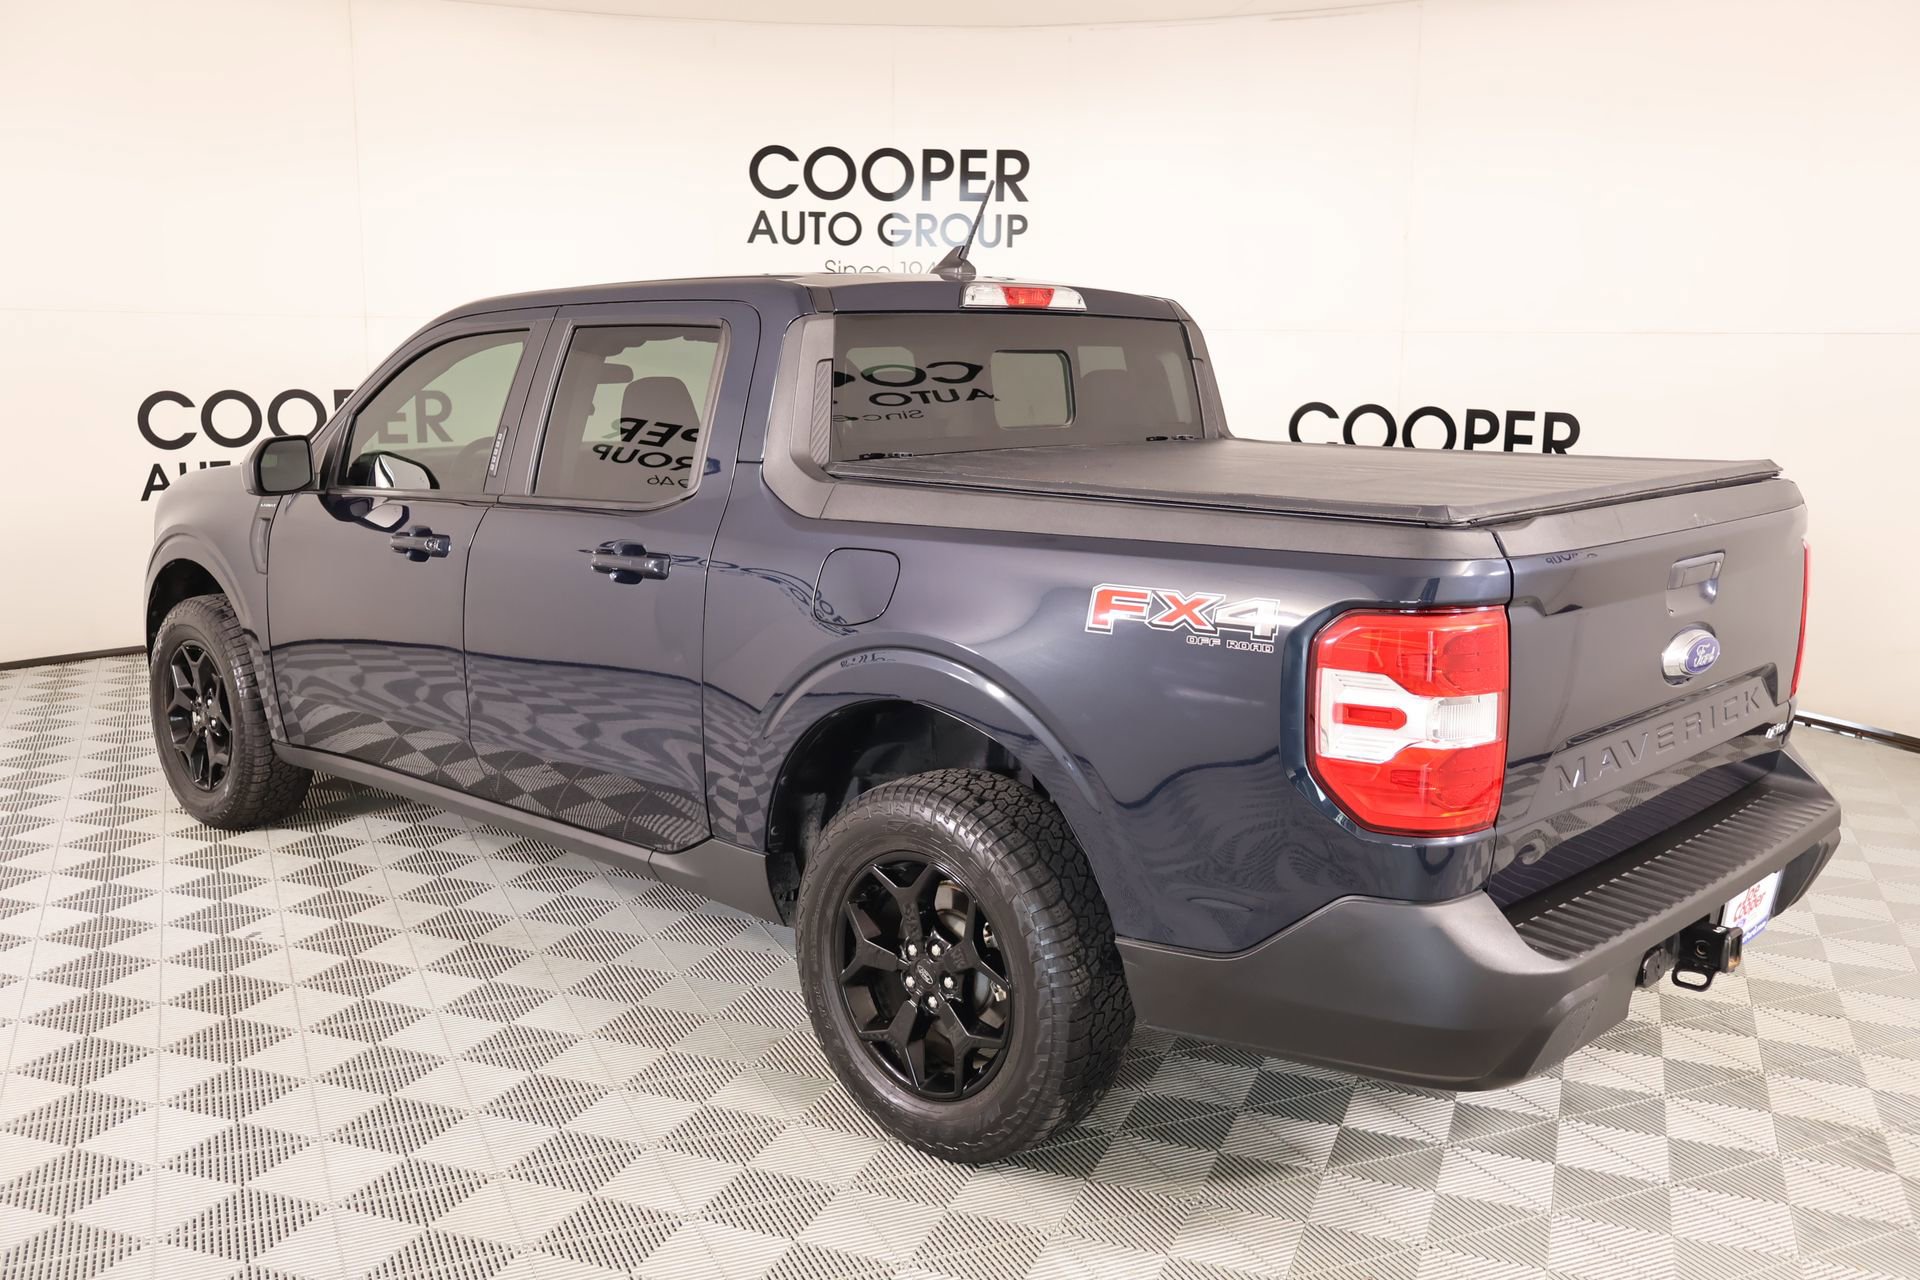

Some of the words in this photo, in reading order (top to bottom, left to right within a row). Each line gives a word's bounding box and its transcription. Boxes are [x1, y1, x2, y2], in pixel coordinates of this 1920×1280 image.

[749, 145, 1030, 202] COOPER
[747, 210, 862, 246] AUTO
[878, 212, 1028, 248] GROUP
[1289, 401, 1581, 455] COOPER
[1085, 583, 1280, 642] FX4
[1186, 635, 1221, 647] OFF
[1226, 640, 1274, 653] ROAD
[1555, 686, 1761, 796] MAVERICK
